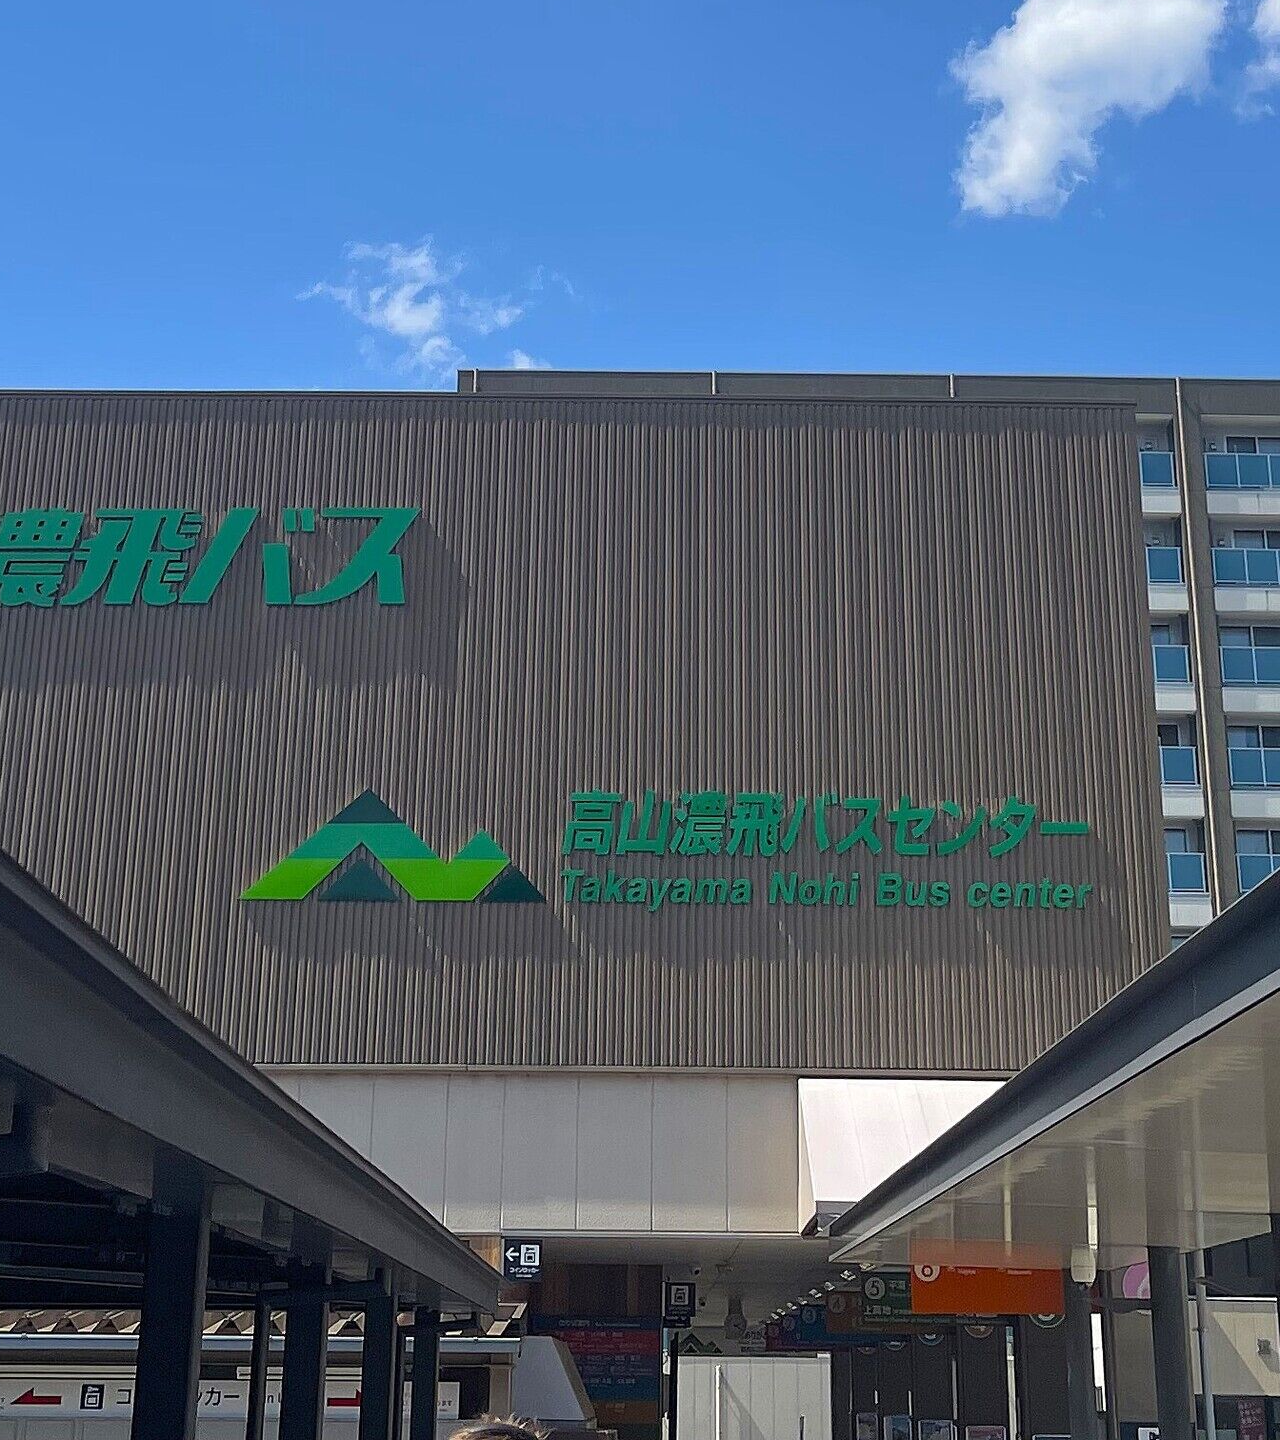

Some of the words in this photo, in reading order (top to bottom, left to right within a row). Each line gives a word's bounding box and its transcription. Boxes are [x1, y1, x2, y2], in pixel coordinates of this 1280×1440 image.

[561, 788, 1089, 858] 高山濃飛バスセンター
[560, 869, 752, 912] Takayama
[770, 870, 860, 906] Nohi
[876, 871, 951, 907] Bus
[967, 876, 1092, 909] center
